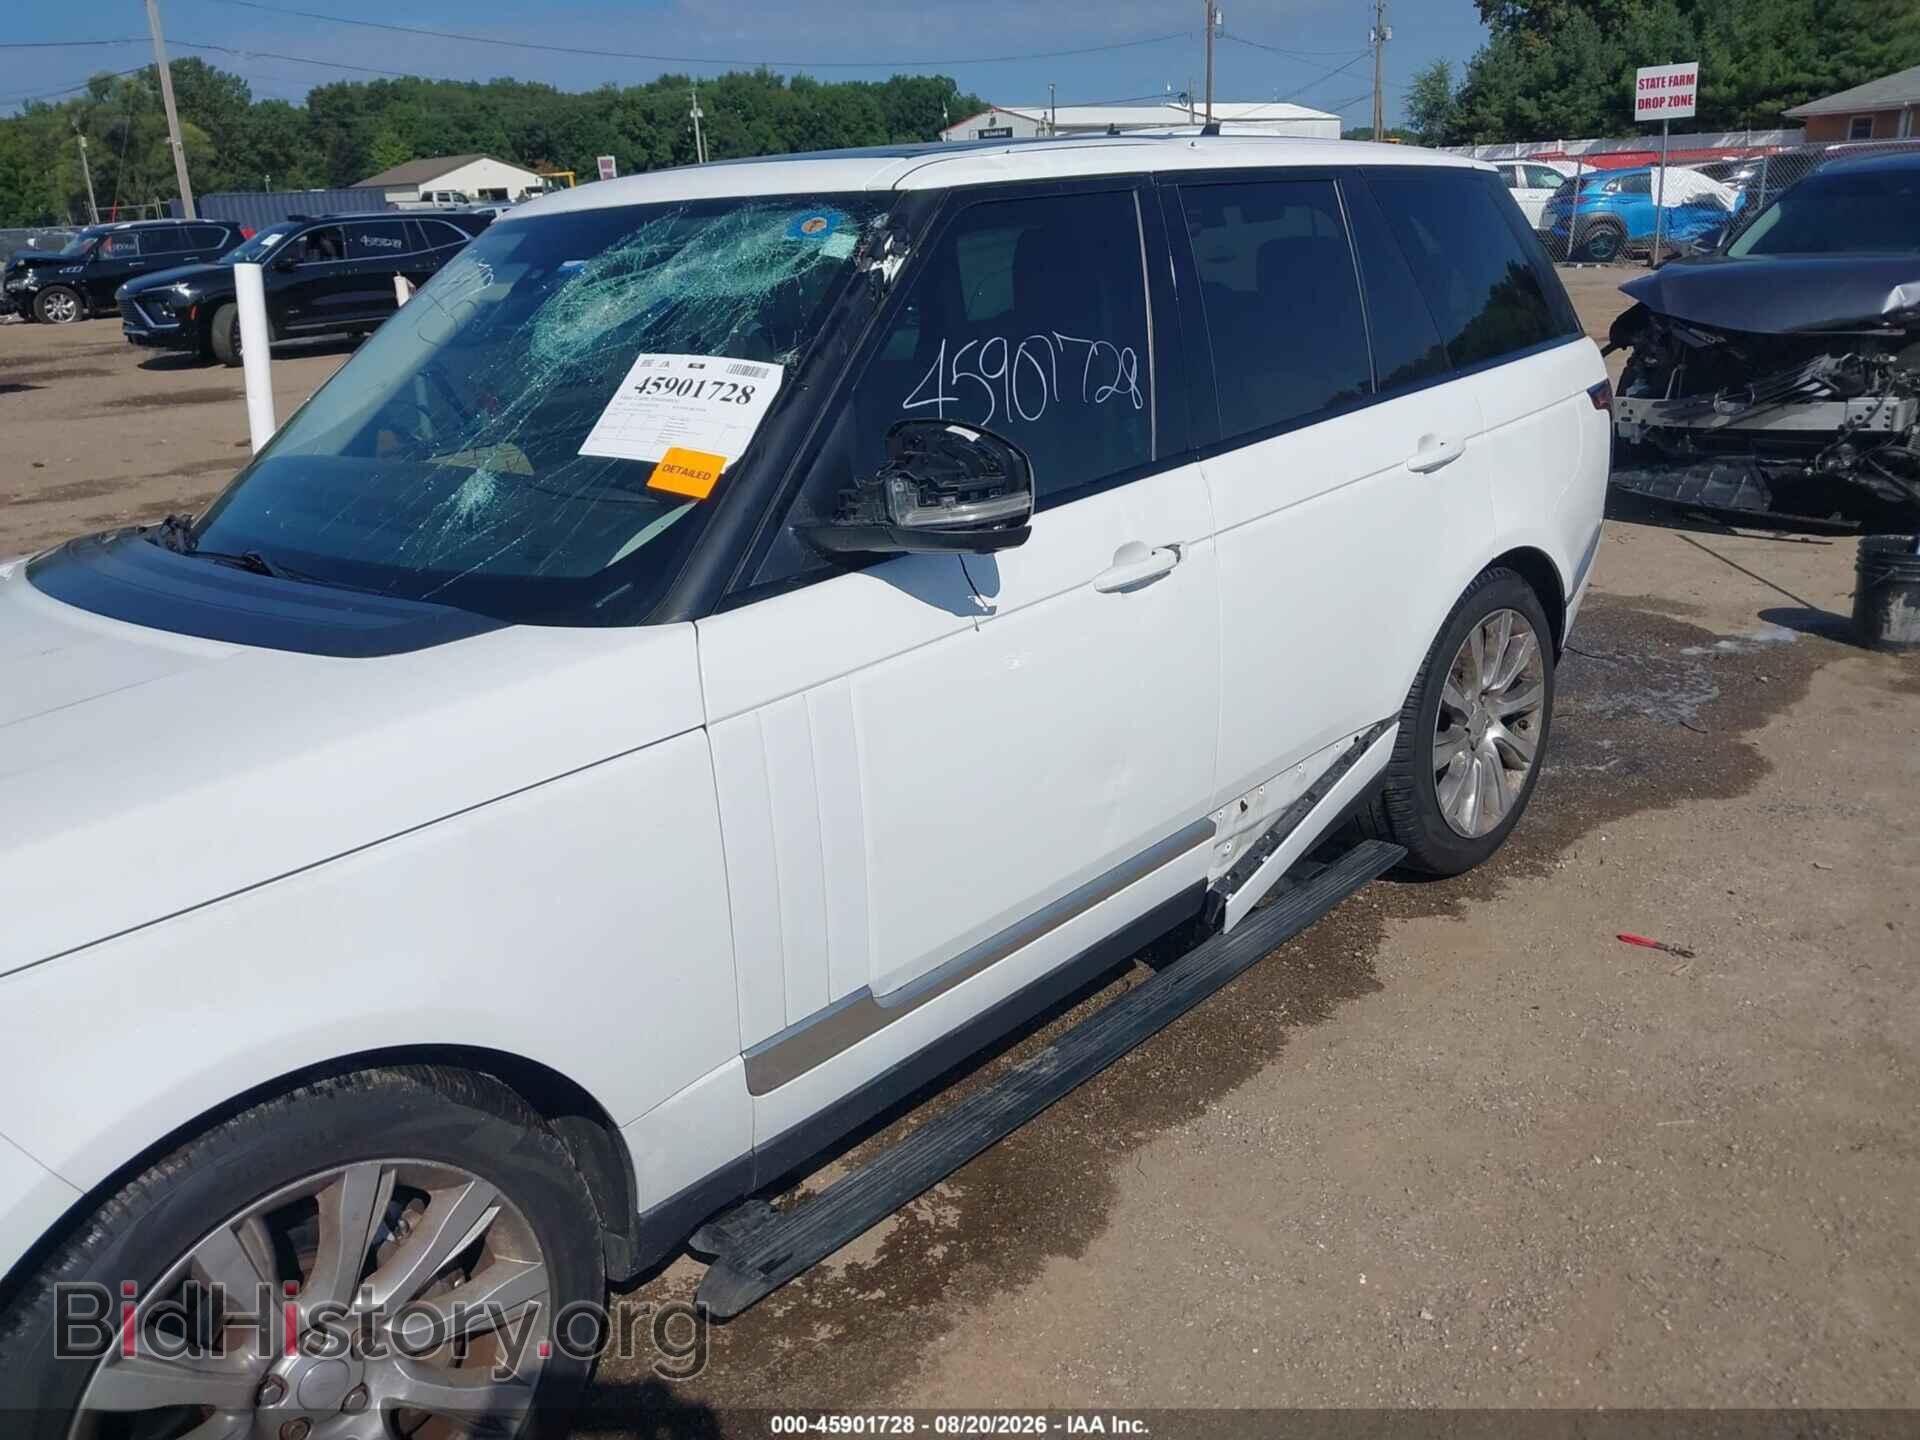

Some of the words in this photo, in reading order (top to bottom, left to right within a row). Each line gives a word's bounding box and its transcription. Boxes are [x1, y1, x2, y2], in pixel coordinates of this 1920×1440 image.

[1638, 77, 1666, 90] STATE
[1668, 74, 1695, 87] FARM
[1638, 96, 1665, 110] DROP
[1668, 94, 1693, 107] ZONE
[902, 330, 1143, 426] 45901728
[634, 376, 756, 405] 45901728
[662, 463, 712, 481] DETAILED
